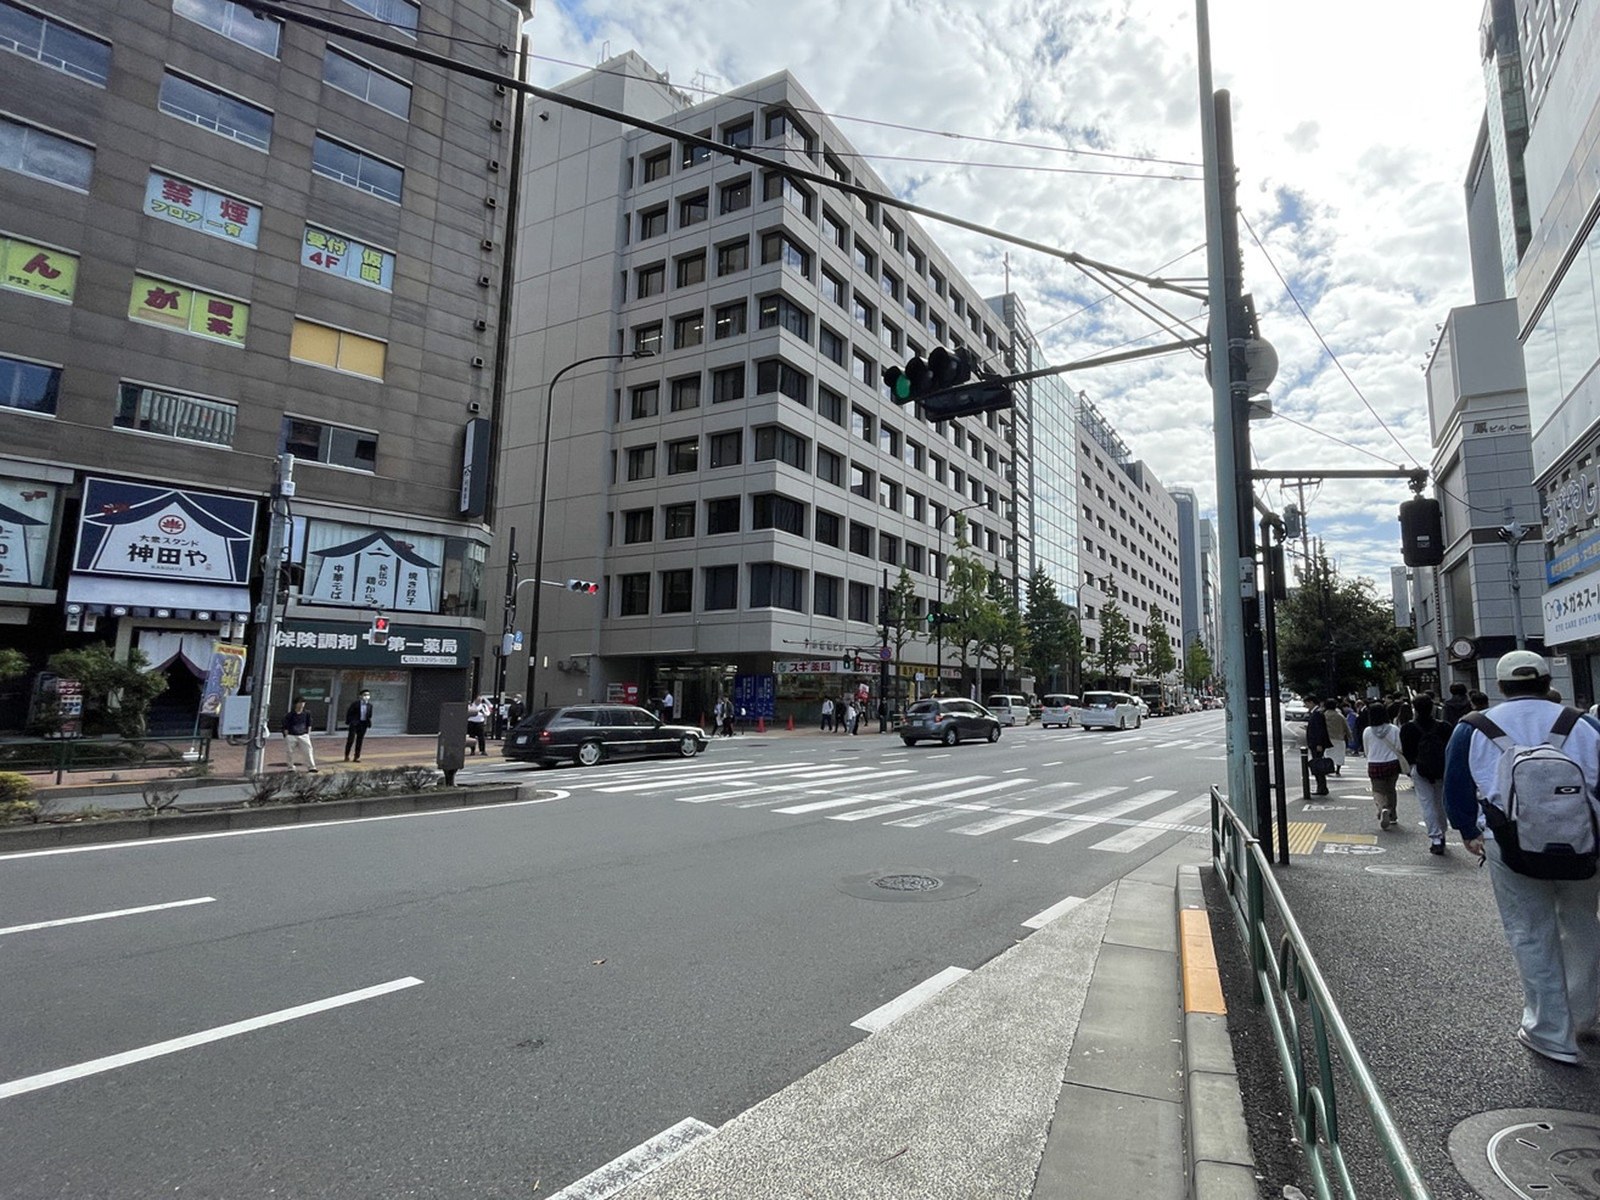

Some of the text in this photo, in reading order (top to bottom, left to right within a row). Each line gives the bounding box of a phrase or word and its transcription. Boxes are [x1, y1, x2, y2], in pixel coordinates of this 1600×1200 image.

[162, 180, 249, 226] 禁煙
[306, 230, 347, 256] 受付
[309, 252, 340, 268] 4F
[22, 253, 61, 279] ん
[144, 287, 180, 309] が
[1543, 465, 1600, 541] こばやし
[139, 534, 199, 547] 大衆スタンド
[127, 543, 207, 566] 神田や
[330, 564, 344, 600] 中華そば
[274, 630, 458, 654] 保険調剤 第一薬局
[789, 662, 831, 672] スギ薬局
